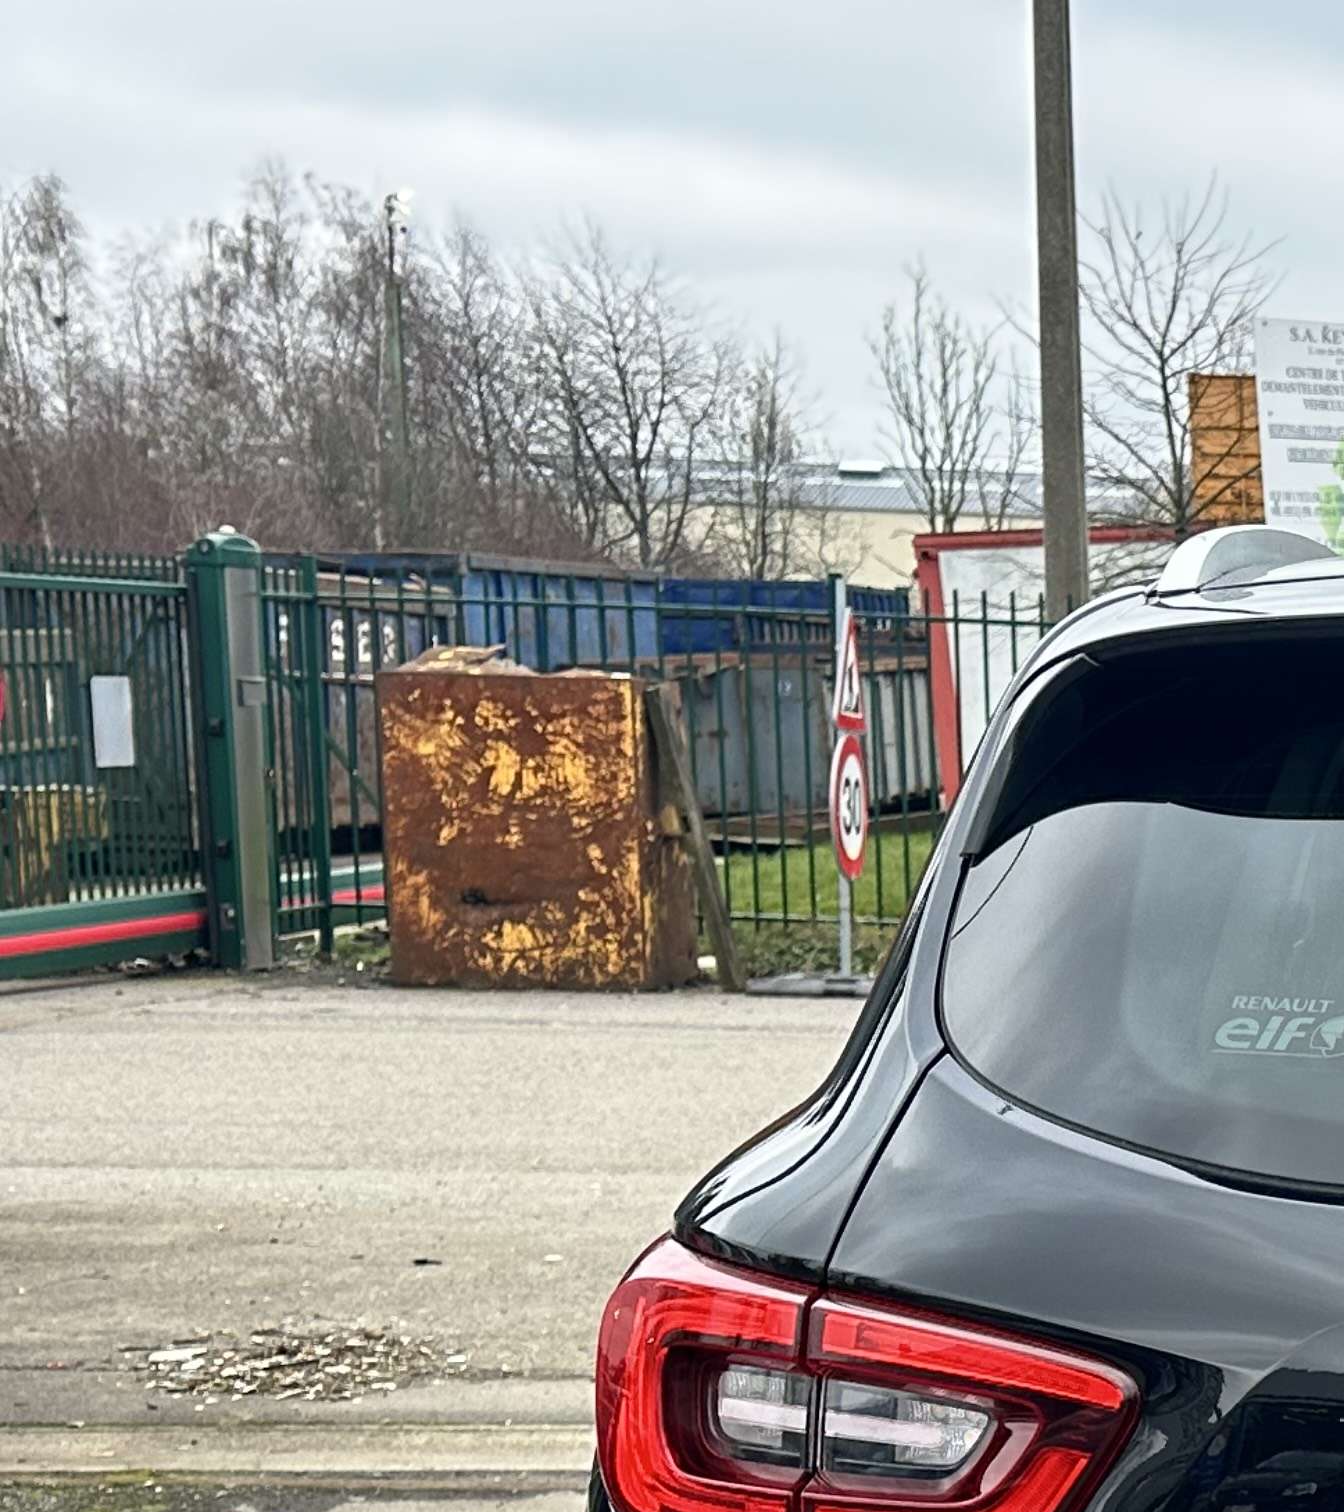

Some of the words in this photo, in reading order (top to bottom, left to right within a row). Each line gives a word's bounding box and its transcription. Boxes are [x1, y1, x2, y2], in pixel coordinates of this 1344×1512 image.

[1289, 326, 1317, 343] S.A.
[844, 776, 862, 835] 30
[1231, 995, 1335, 1013] RENAULT
[1214, 1015, 1317, 1051] elf
